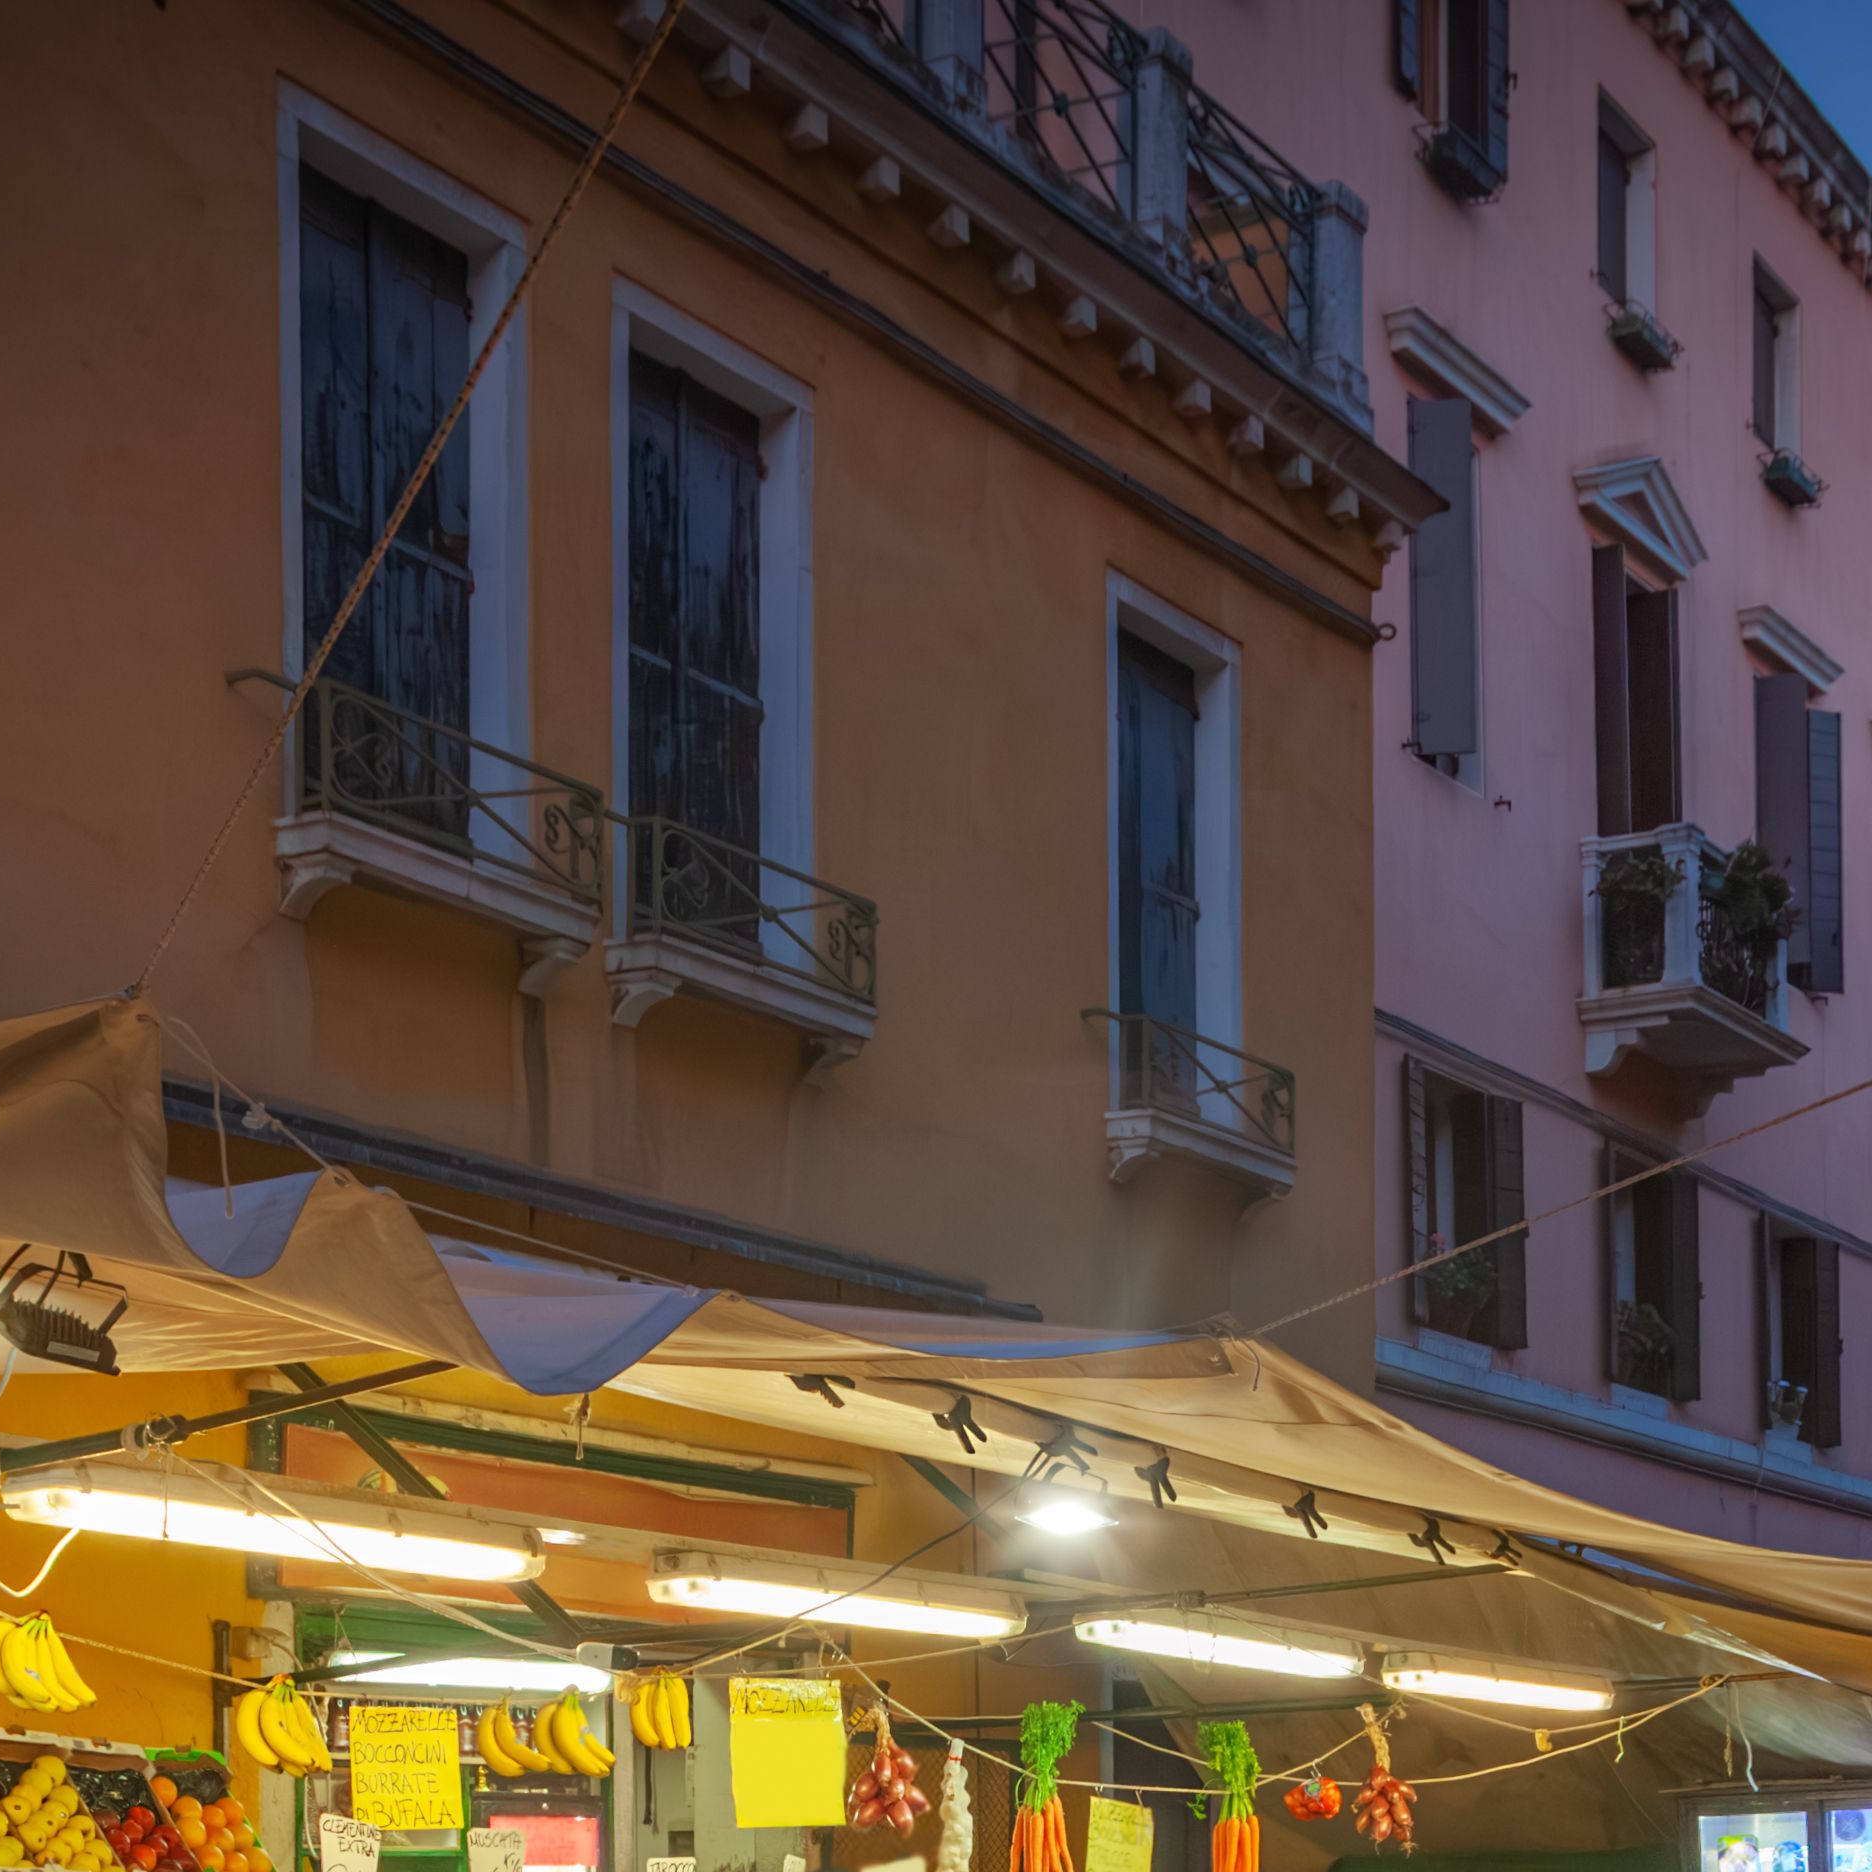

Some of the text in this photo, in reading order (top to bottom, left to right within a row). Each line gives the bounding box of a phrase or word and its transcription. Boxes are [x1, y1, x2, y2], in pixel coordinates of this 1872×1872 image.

[352, 1709, 456, 1733] MOZZARELLE
[354, 1741, 447, 1765] BOCCONCINI
[355, 1772, 440, 1794] BURRATE
[372, 1798, 456, 1829] BUFALA
[337, 1836, 376, 1859] EXTRA
